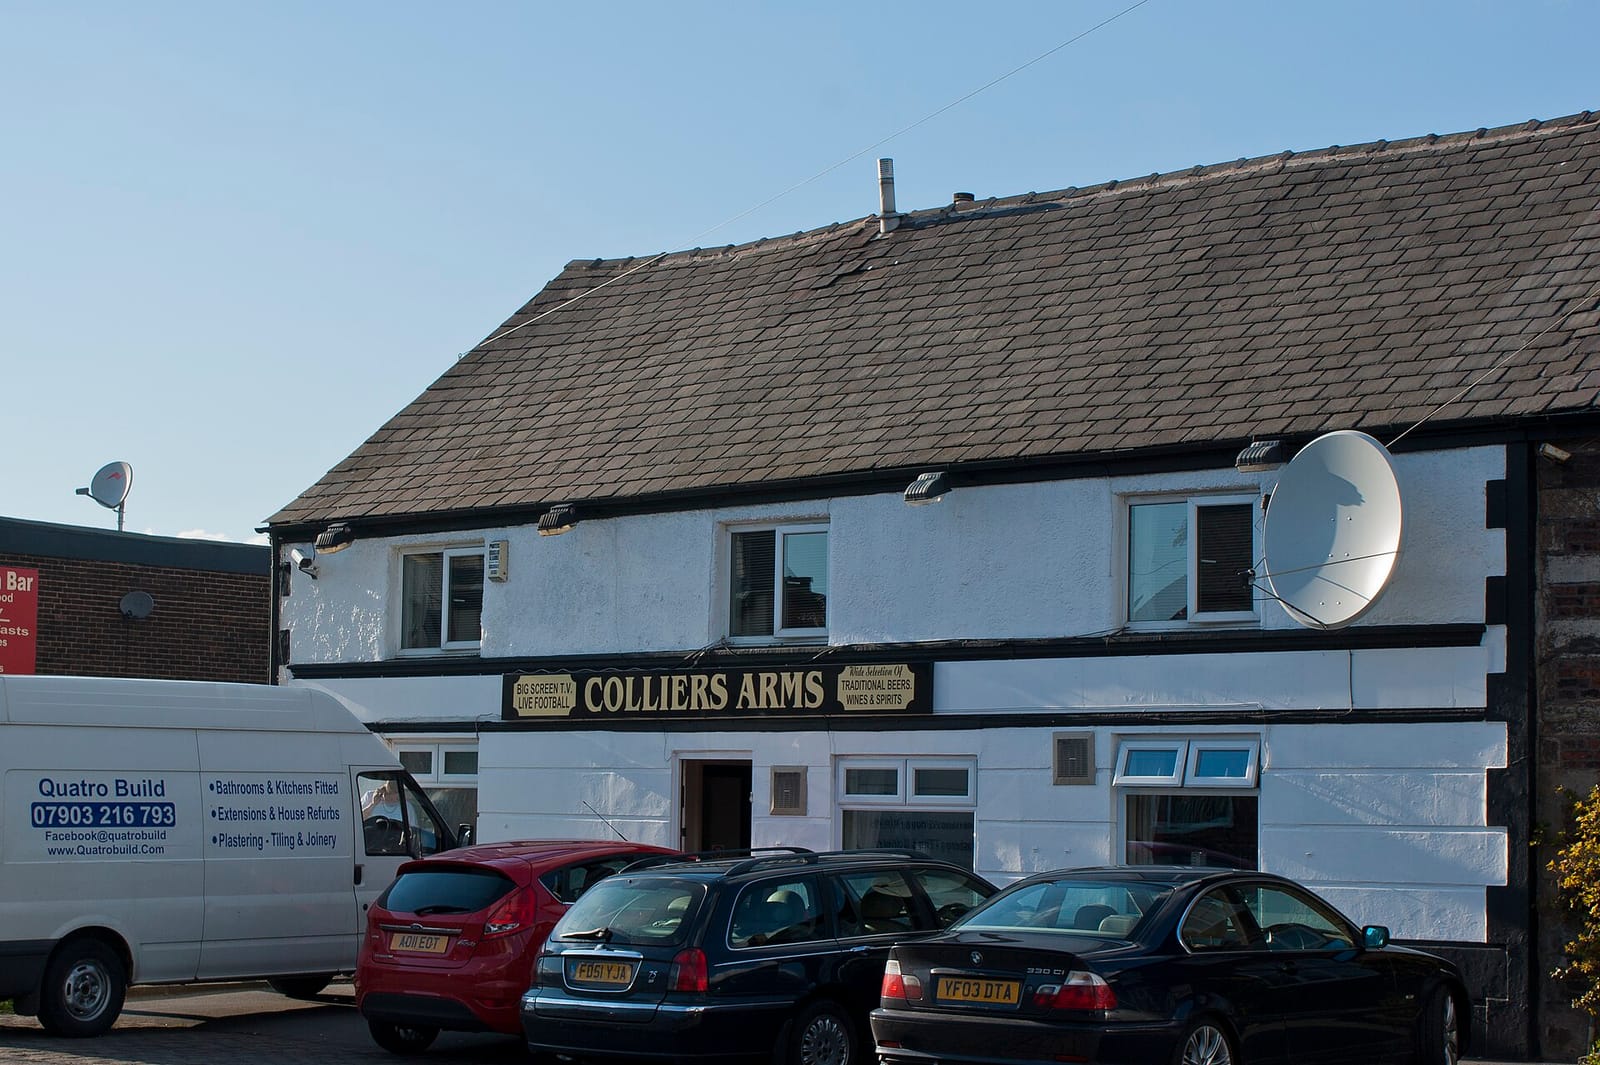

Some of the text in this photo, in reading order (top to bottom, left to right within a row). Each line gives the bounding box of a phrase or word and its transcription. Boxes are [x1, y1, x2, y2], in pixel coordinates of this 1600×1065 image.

[7, 571, 33, 591] Bar
[0, 626, 29, 637] asts
[865, 666, 893, 677] Selection
[894, 665, 904, 678] Of
[517, 682, 573, 695] BIG SCREEN T.V.
[584, 671, 825, 713] COLLIERS ARMS
[841, 680, 886, 691] TRADITIONAL
[518, 696, 570, 709] LIVE FOOTBALL
[846, 694, 903, 705] WINES & SPIRITS
[38, 778, 166, 798] Quatro Build
[215, 780, 339, 795] Bathrooms & Kitchens Fitted
[33, 806, 175, 825] 07903 216 793
[218, 806, 340, 821] Extensions & House Refurbs
[45, 830, 167, 843] Facebook@quatrobuild
[219, 833, 264, 851] Plastering
[270, 832, 295, 850] Tiling
[297, 832, 304, 846] &
[305, 832, 337, 849] Joinery
[48, 844, 165, 856] www.Quatrobuild.Com
[606, 964, 626, 980] YJA
[945, 980, 1011, 1001] YF03 DTA
